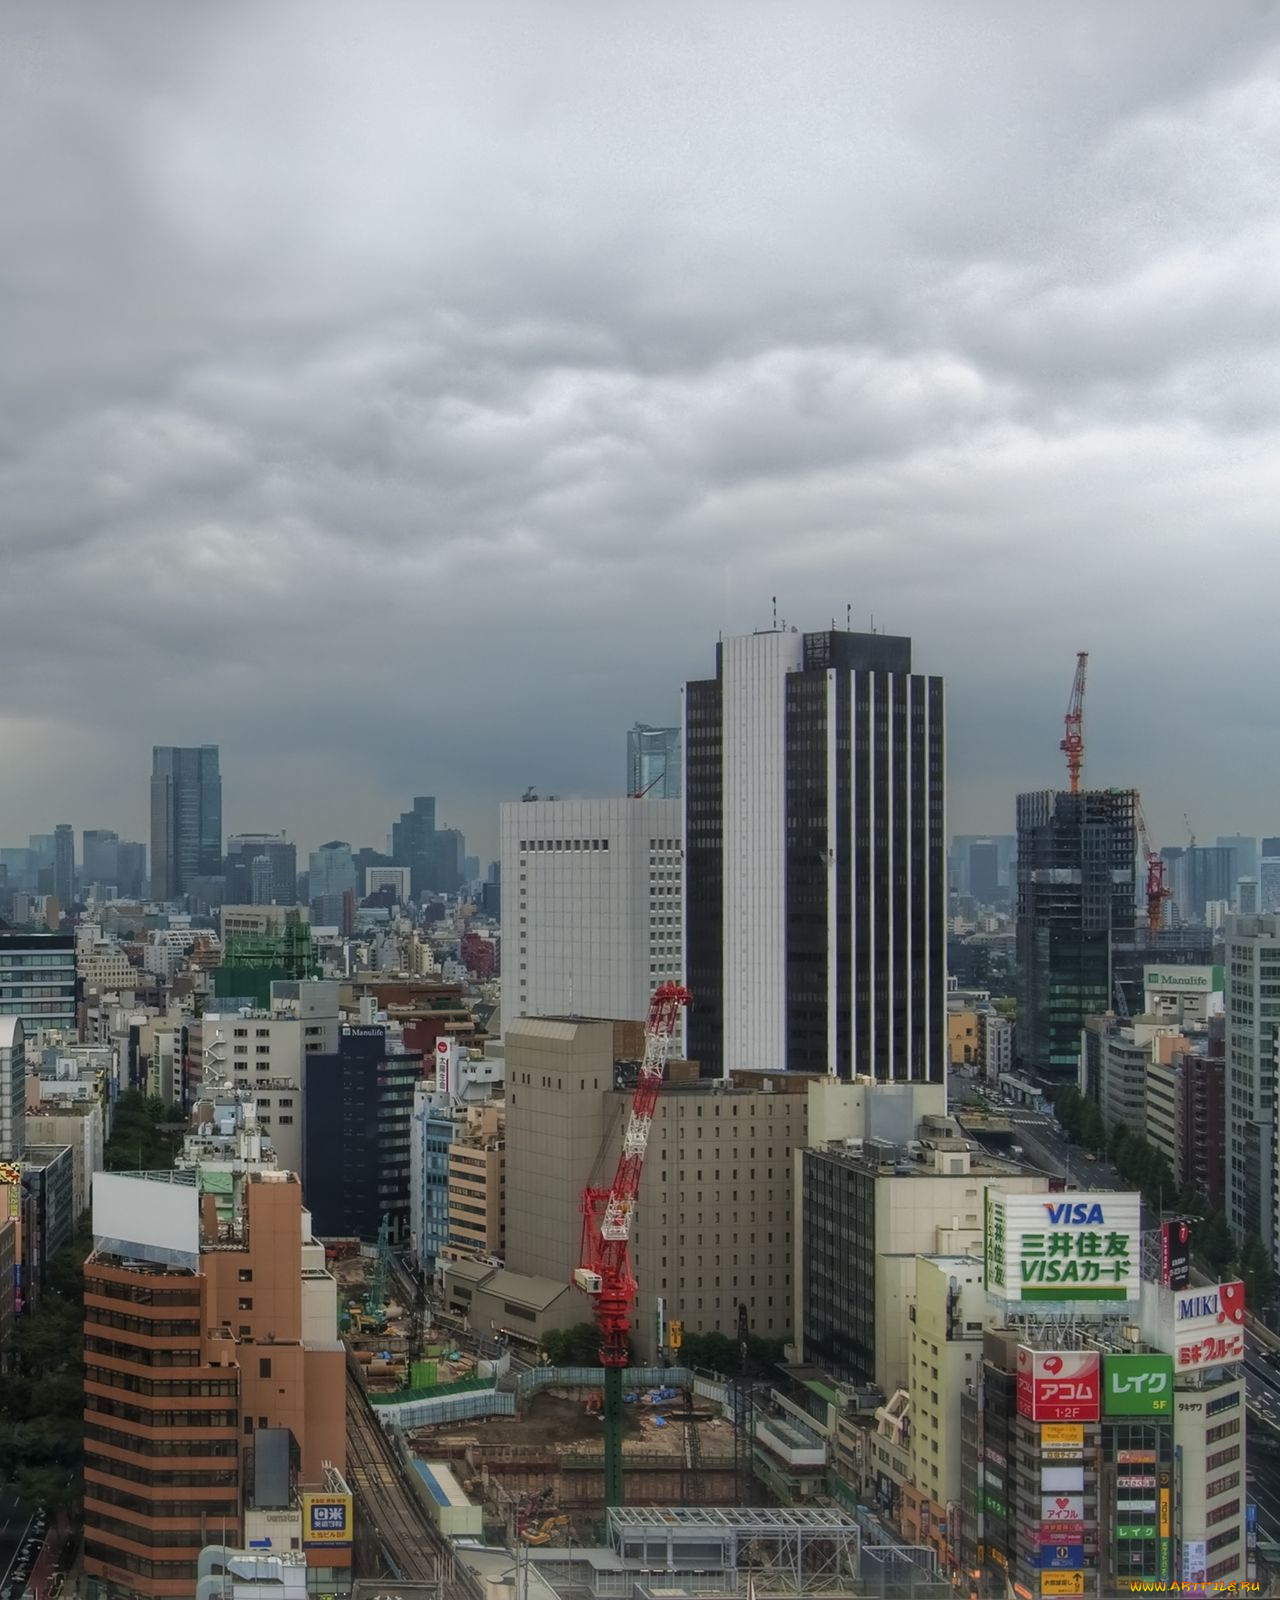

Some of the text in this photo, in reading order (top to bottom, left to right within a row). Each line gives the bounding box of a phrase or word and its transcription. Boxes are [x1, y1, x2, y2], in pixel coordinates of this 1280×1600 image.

[1161, 975, 1208, 985] Manulife
[352, 1028, 383, 1036] Manulife
[1043, 1203, 1104, 1224] VISA
[1020, 1232, 1130, 1257] 三井住友
[1020, 1260, 1131, 1282] VISAカード
[1180, 1294, 1218, 1319] MIKI
[1112, 1372, 1167, 1393] レイク
[1041, 1383, 1093, 1400] アコム
[1152, 1400, 1167, 1409] 5F
[1178, 1403, 1202, 1411] タキザワ
[1047, 1509, 1078, 1519] アイフル
[1119, 1527, 1153, 1537] レイク
